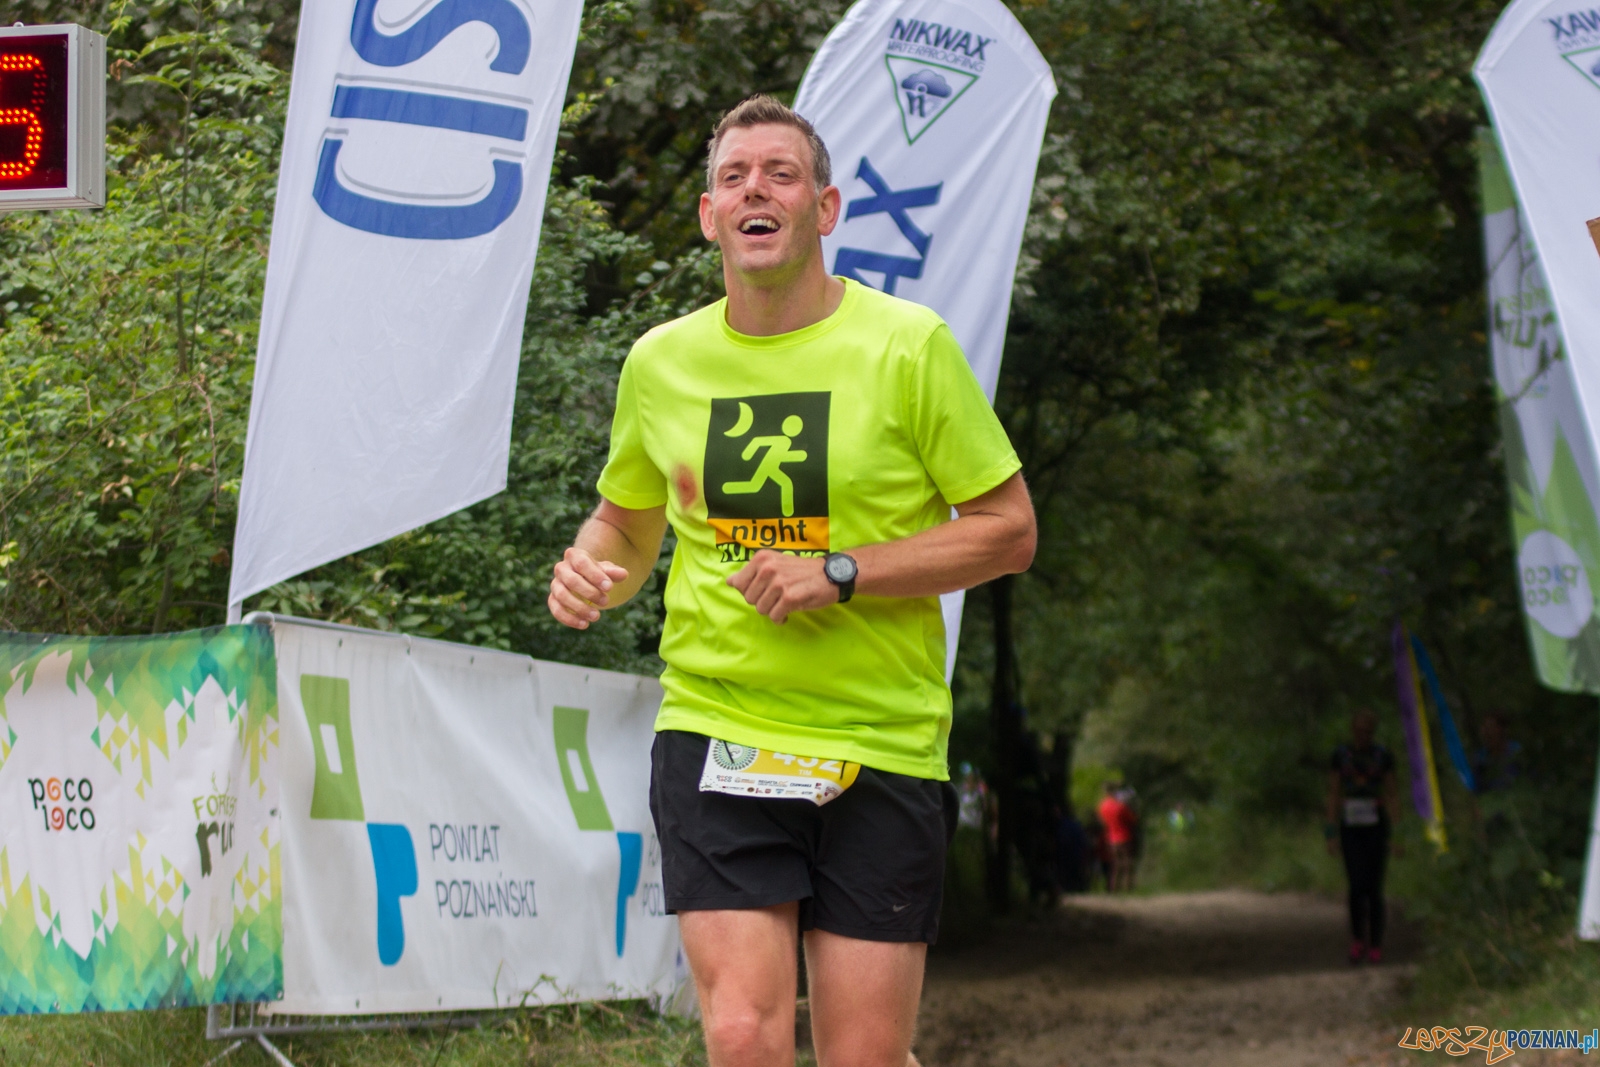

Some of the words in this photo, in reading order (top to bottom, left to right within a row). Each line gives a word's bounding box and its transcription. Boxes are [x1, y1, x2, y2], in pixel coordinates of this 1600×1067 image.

[889, 18, 990, 61] NIKWAX
[886, 40, 986, 73] WATERPROOFING
[731, 518, 807, 547] night
[28, 777, 93, 810] poco
[42, 804, 96, 832] loco
[429, 823, 501, 862] POWIAT
[435, 871, 538, 918] POZNAŃSKI
